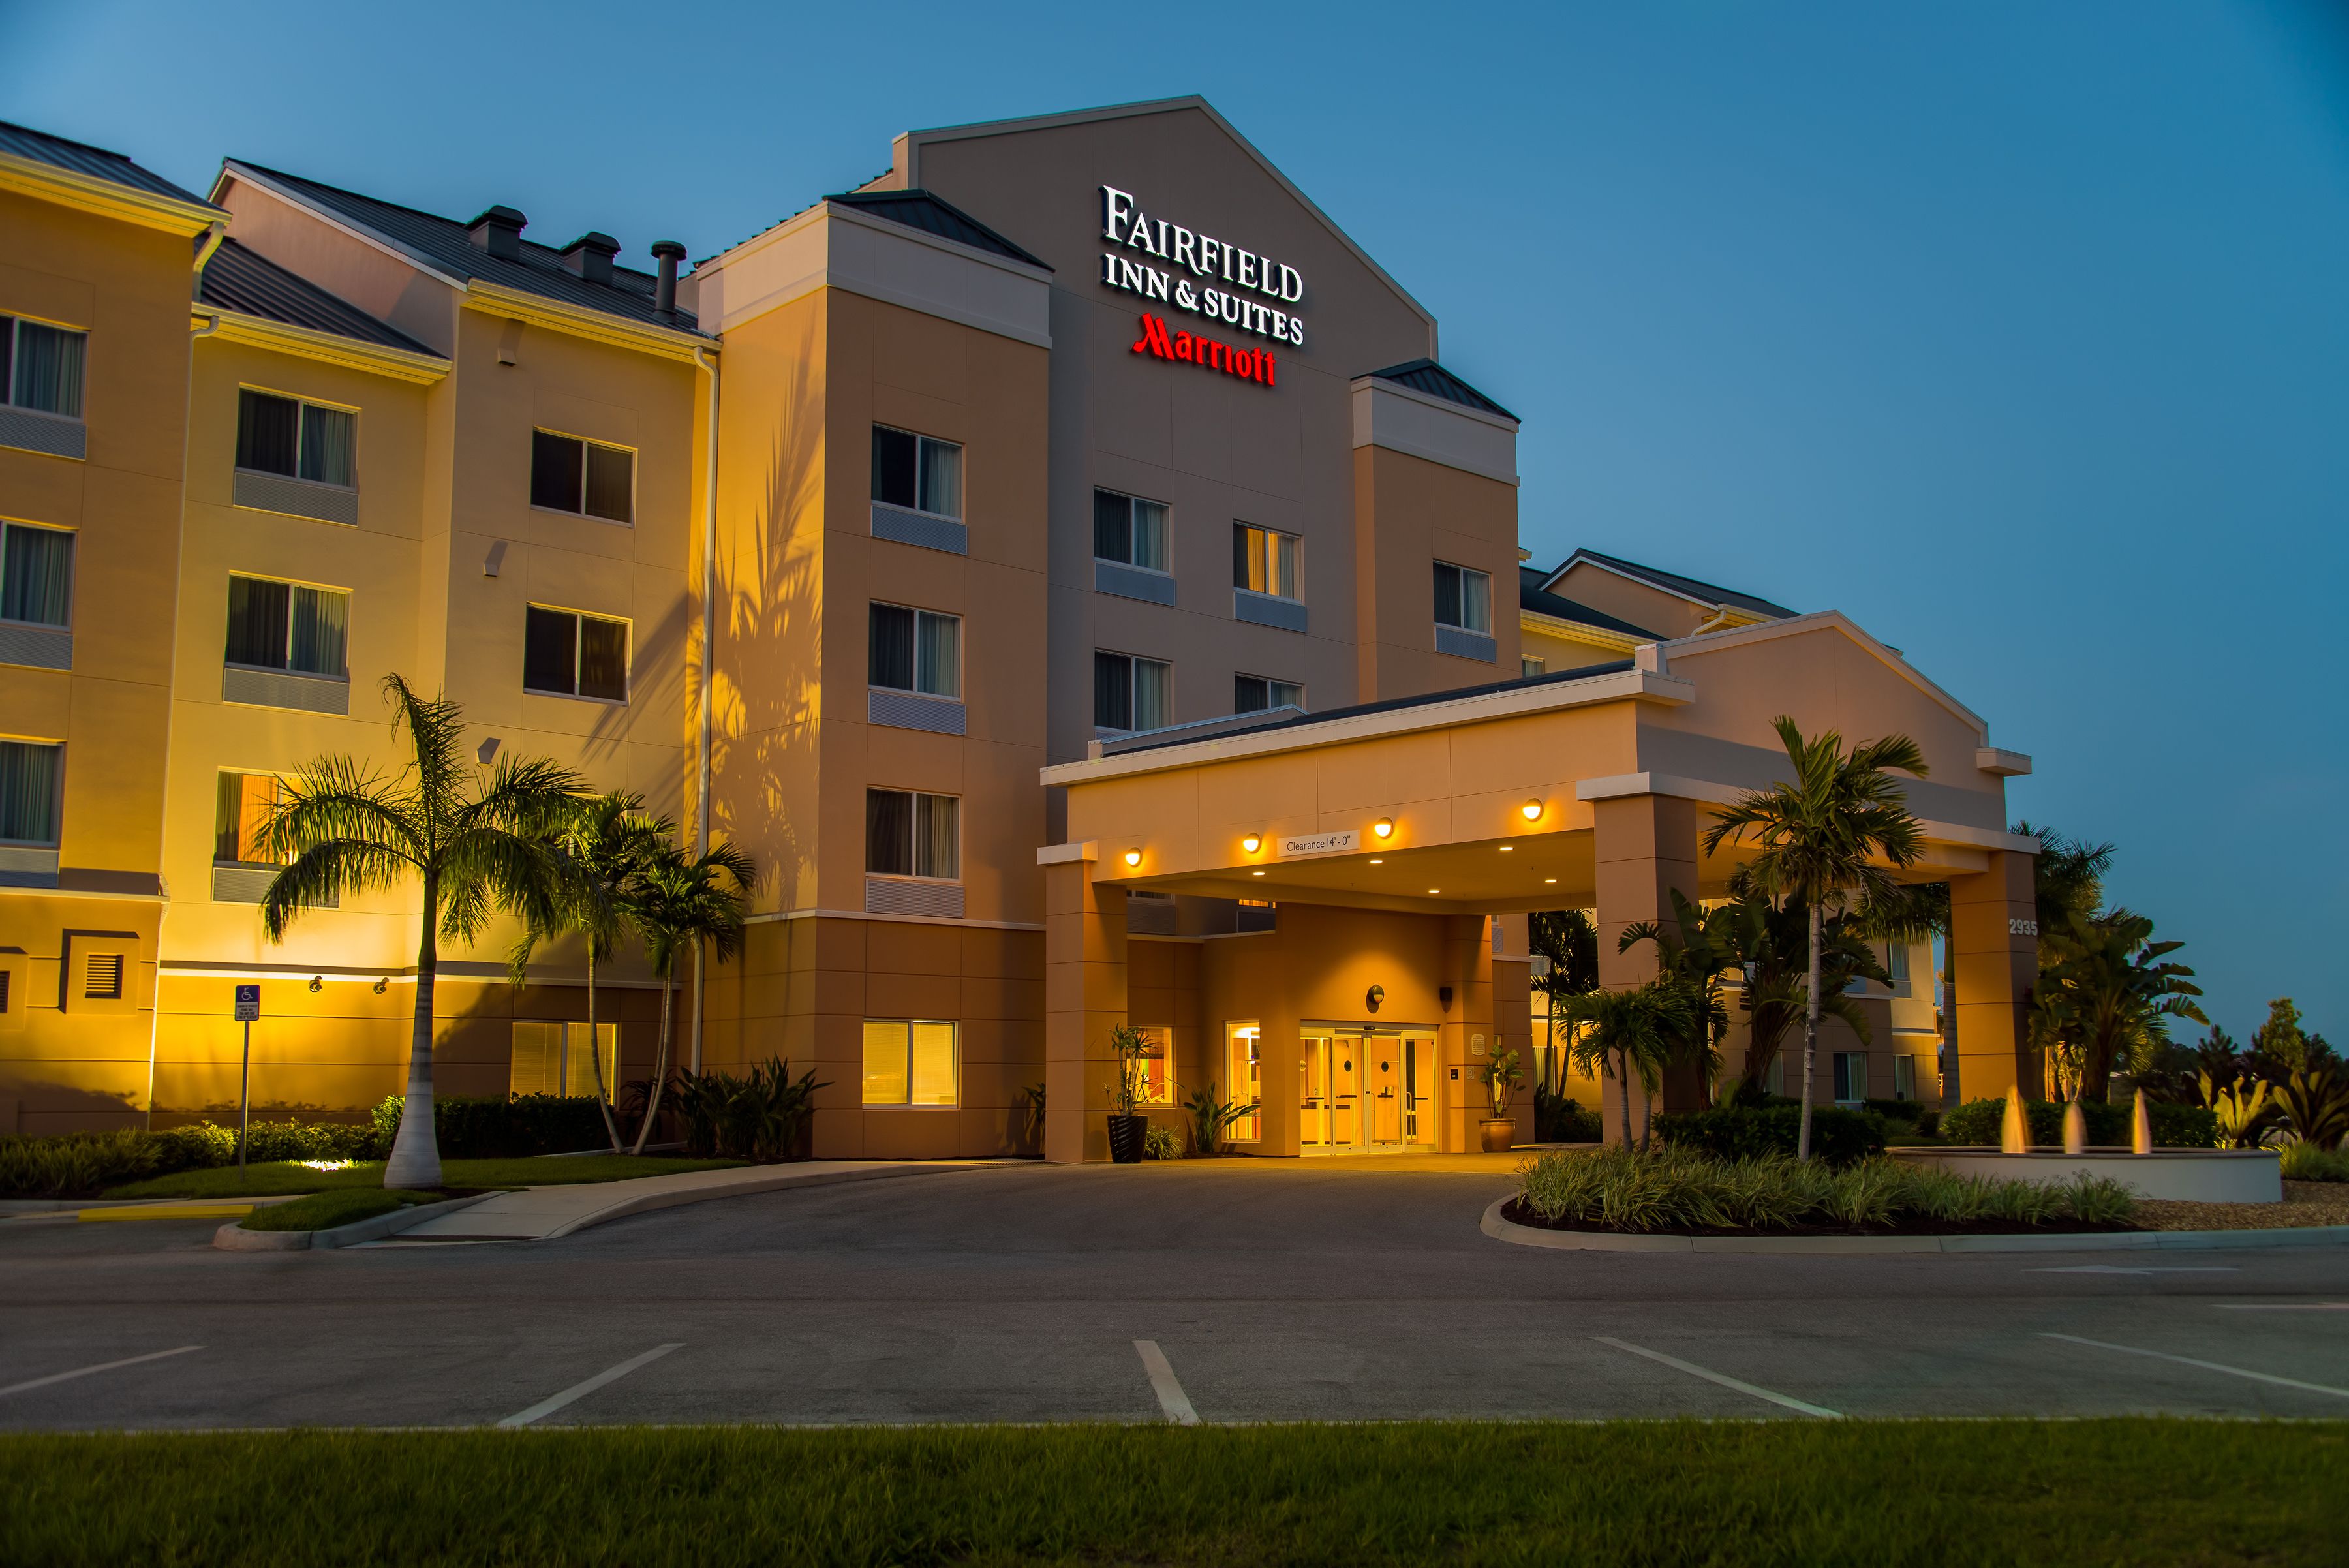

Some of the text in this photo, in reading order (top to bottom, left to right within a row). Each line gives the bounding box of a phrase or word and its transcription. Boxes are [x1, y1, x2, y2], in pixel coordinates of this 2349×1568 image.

[1102, 185, 1302, 303] FAIRFIELD
[1105, 253, 1304, 346] INN & SUITES
[1132, 313, 1277, 386] Marriott
[1287, 841, 1325, 851] Clearance
[2009, 919, 2038, 936] 2935
